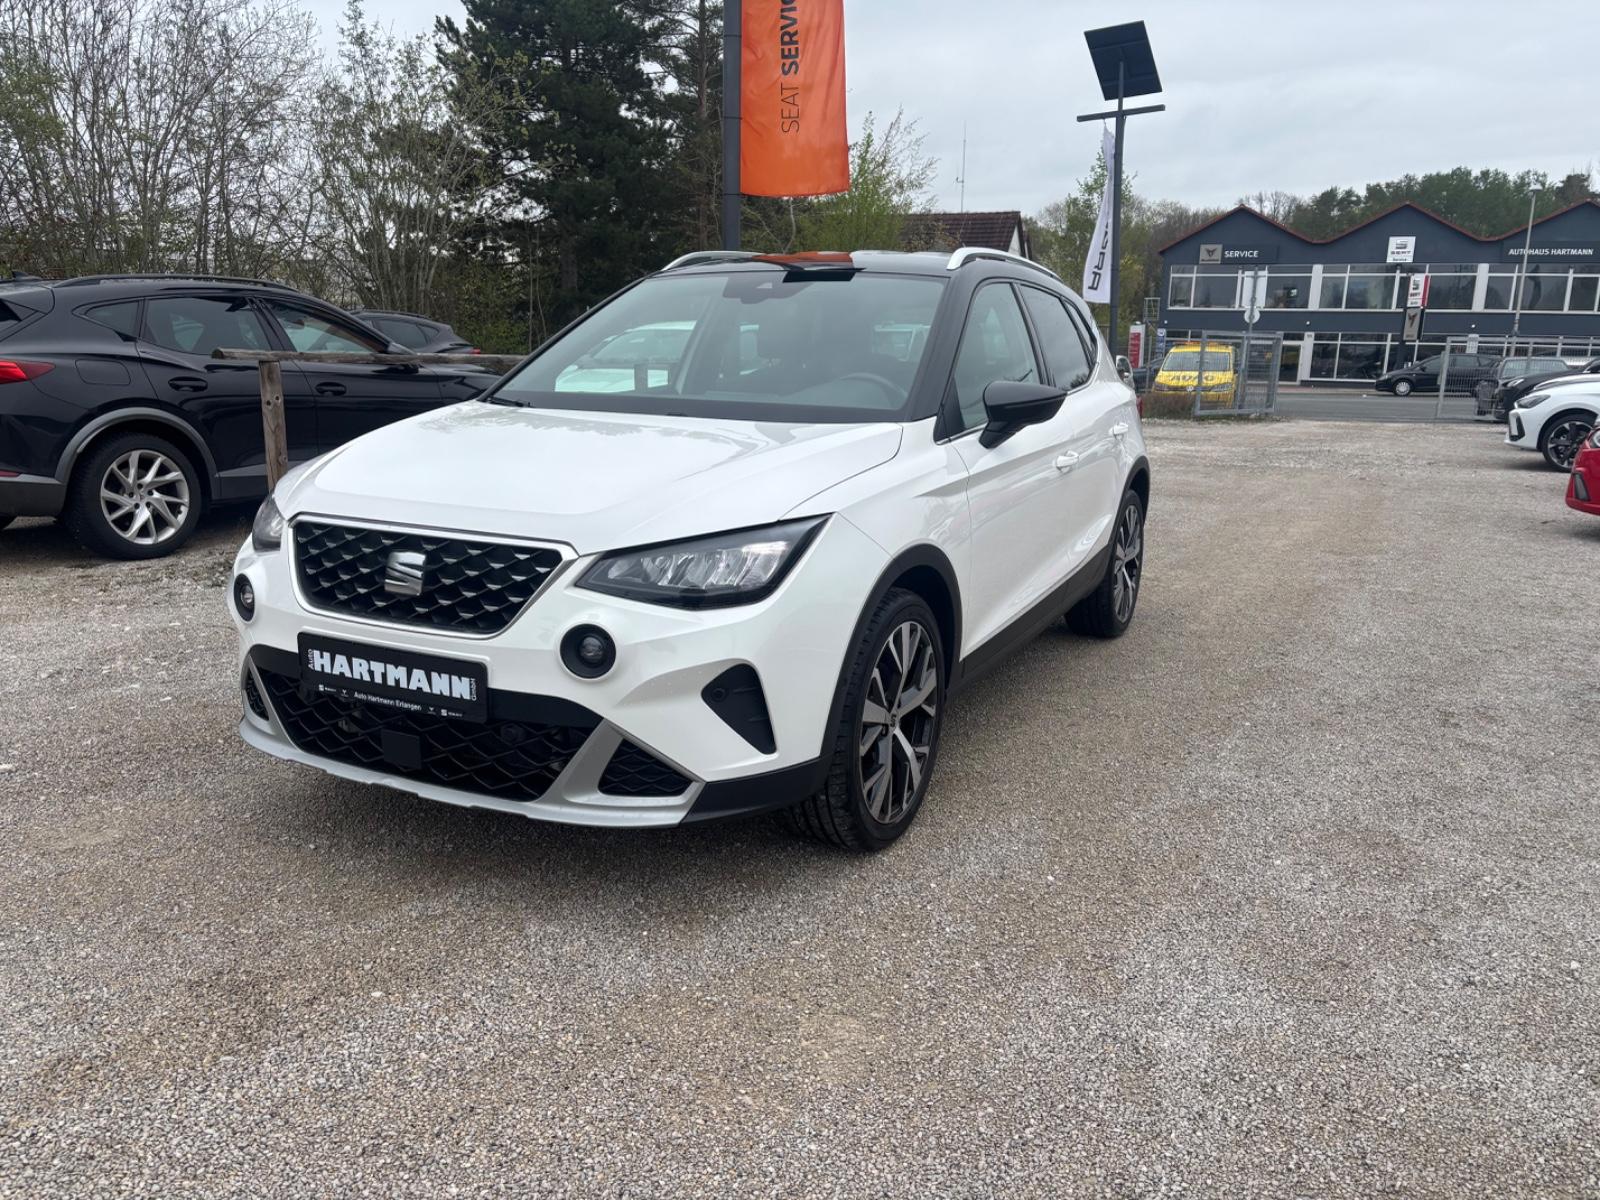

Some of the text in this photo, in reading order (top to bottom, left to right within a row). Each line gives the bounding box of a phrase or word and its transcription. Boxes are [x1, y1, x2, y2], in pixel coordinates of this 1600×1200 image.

[781, 82, 800, 133] SEAT
[1224, 250, 1259, 258] SERVICE
[1550, 248, 1594, 256] HARTMANN
[314, 650, 471, 700] HARTMANN
[353, 691, 368, 700] Auto
